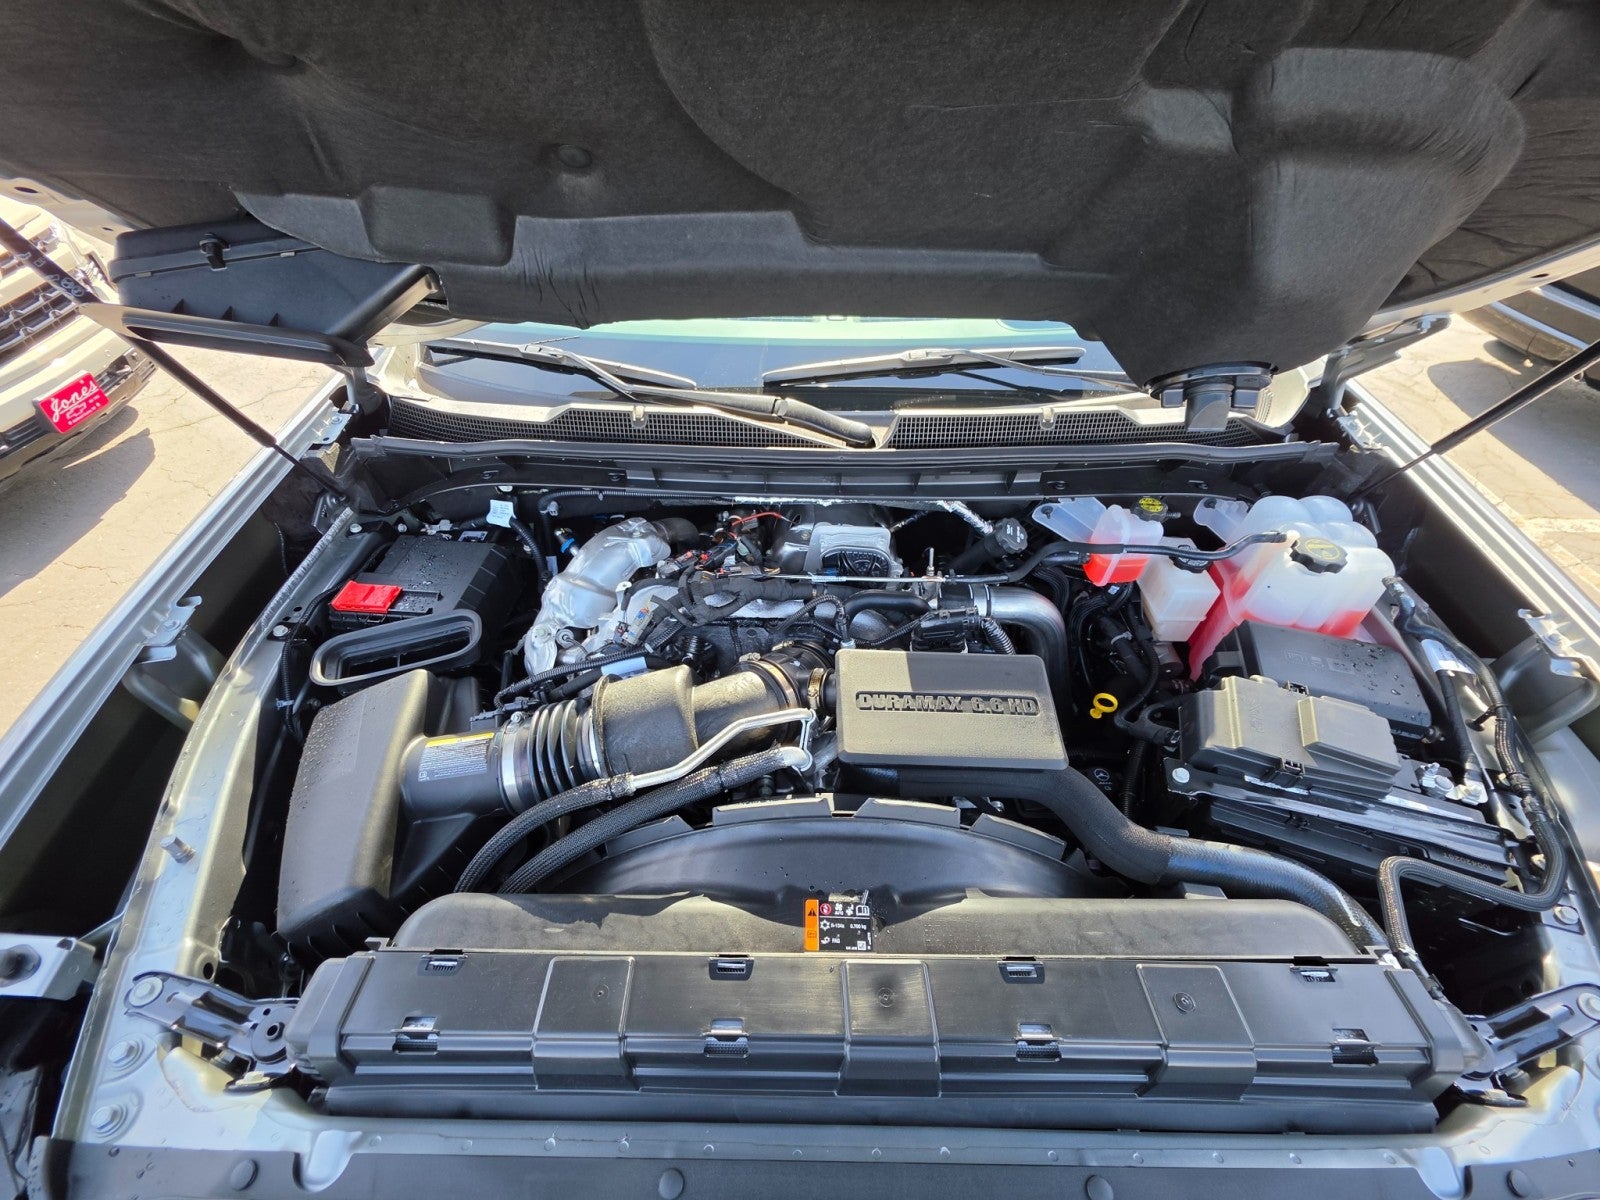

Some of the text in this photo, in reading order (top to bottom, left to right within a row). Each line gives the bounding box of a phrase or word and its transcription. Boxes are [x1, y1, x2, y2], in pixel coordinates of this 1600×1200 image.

[51, 380, 99, 423] Jones
[858, 693, 1037, 716] DURAMAX 6.6 HD
